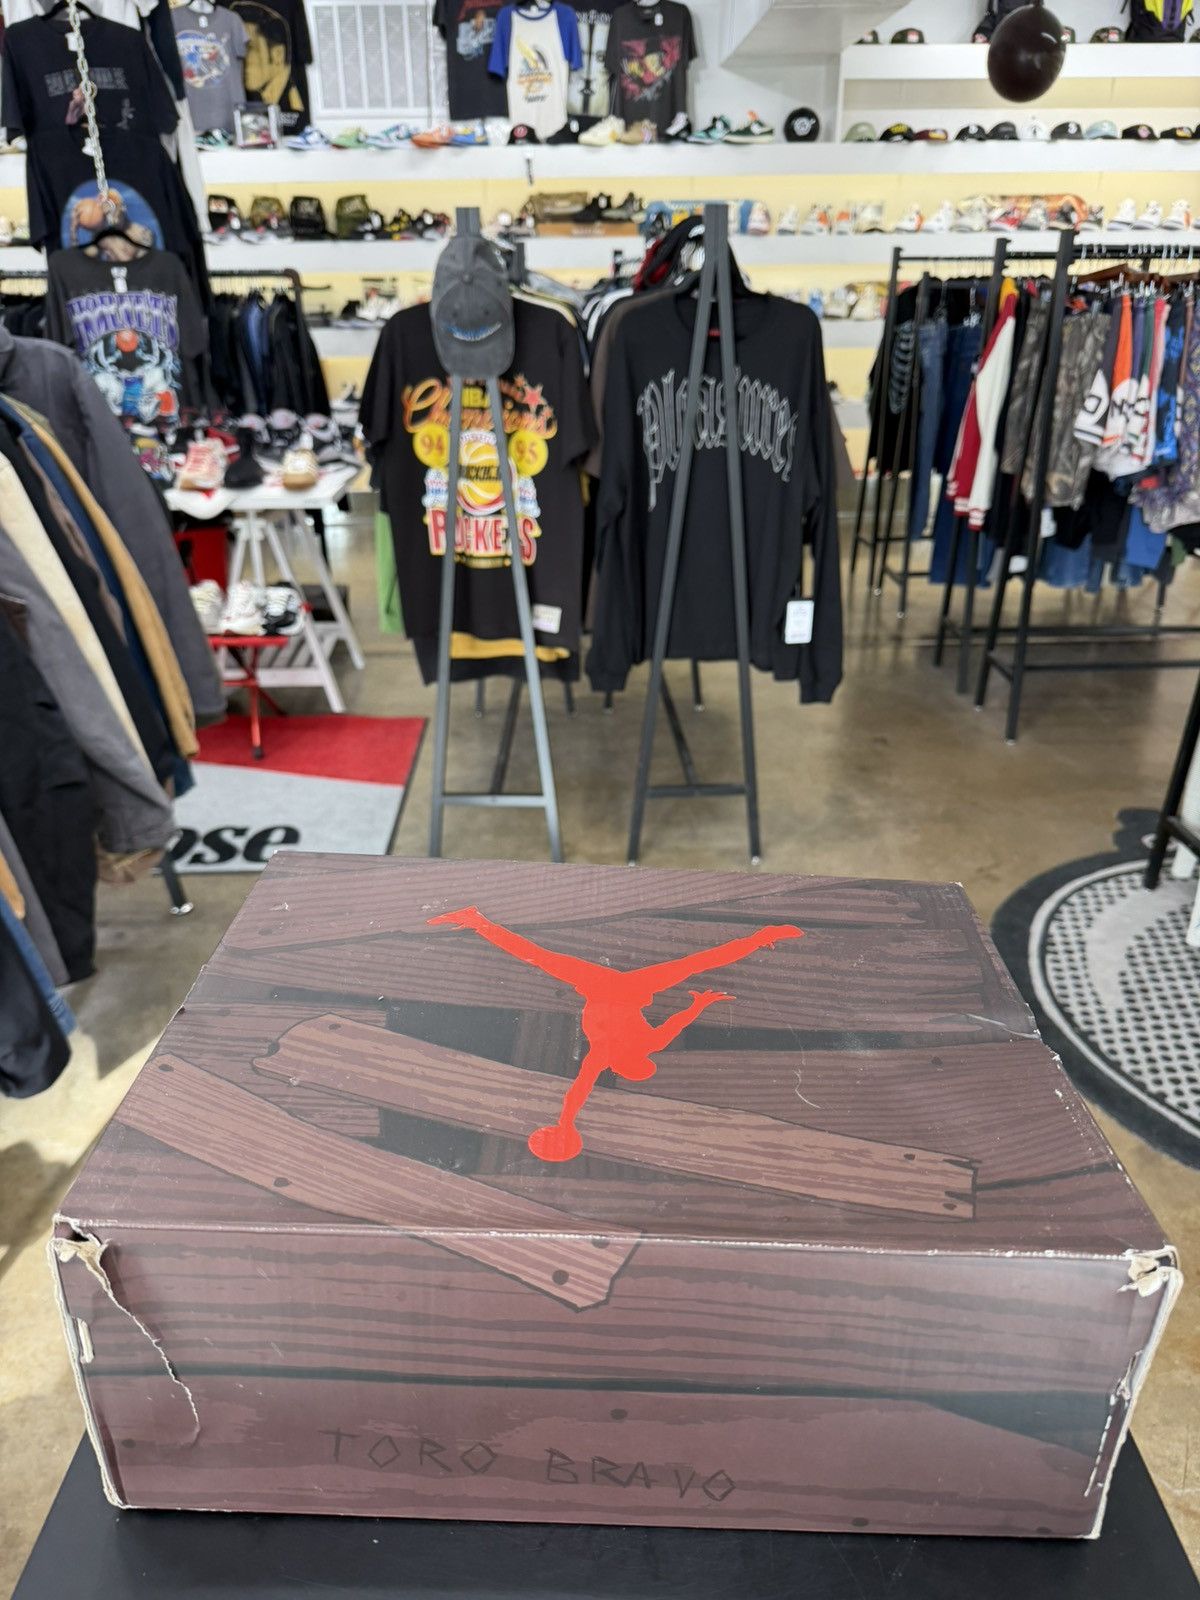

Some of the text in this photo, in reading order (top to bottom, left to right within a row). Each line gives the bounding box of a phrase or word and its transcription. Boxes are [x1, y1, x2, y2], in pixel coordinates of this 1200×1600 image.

[428, 508, 537, 565] ROCKES
[318, 1427, 737, 1502] TORO BRAVO
